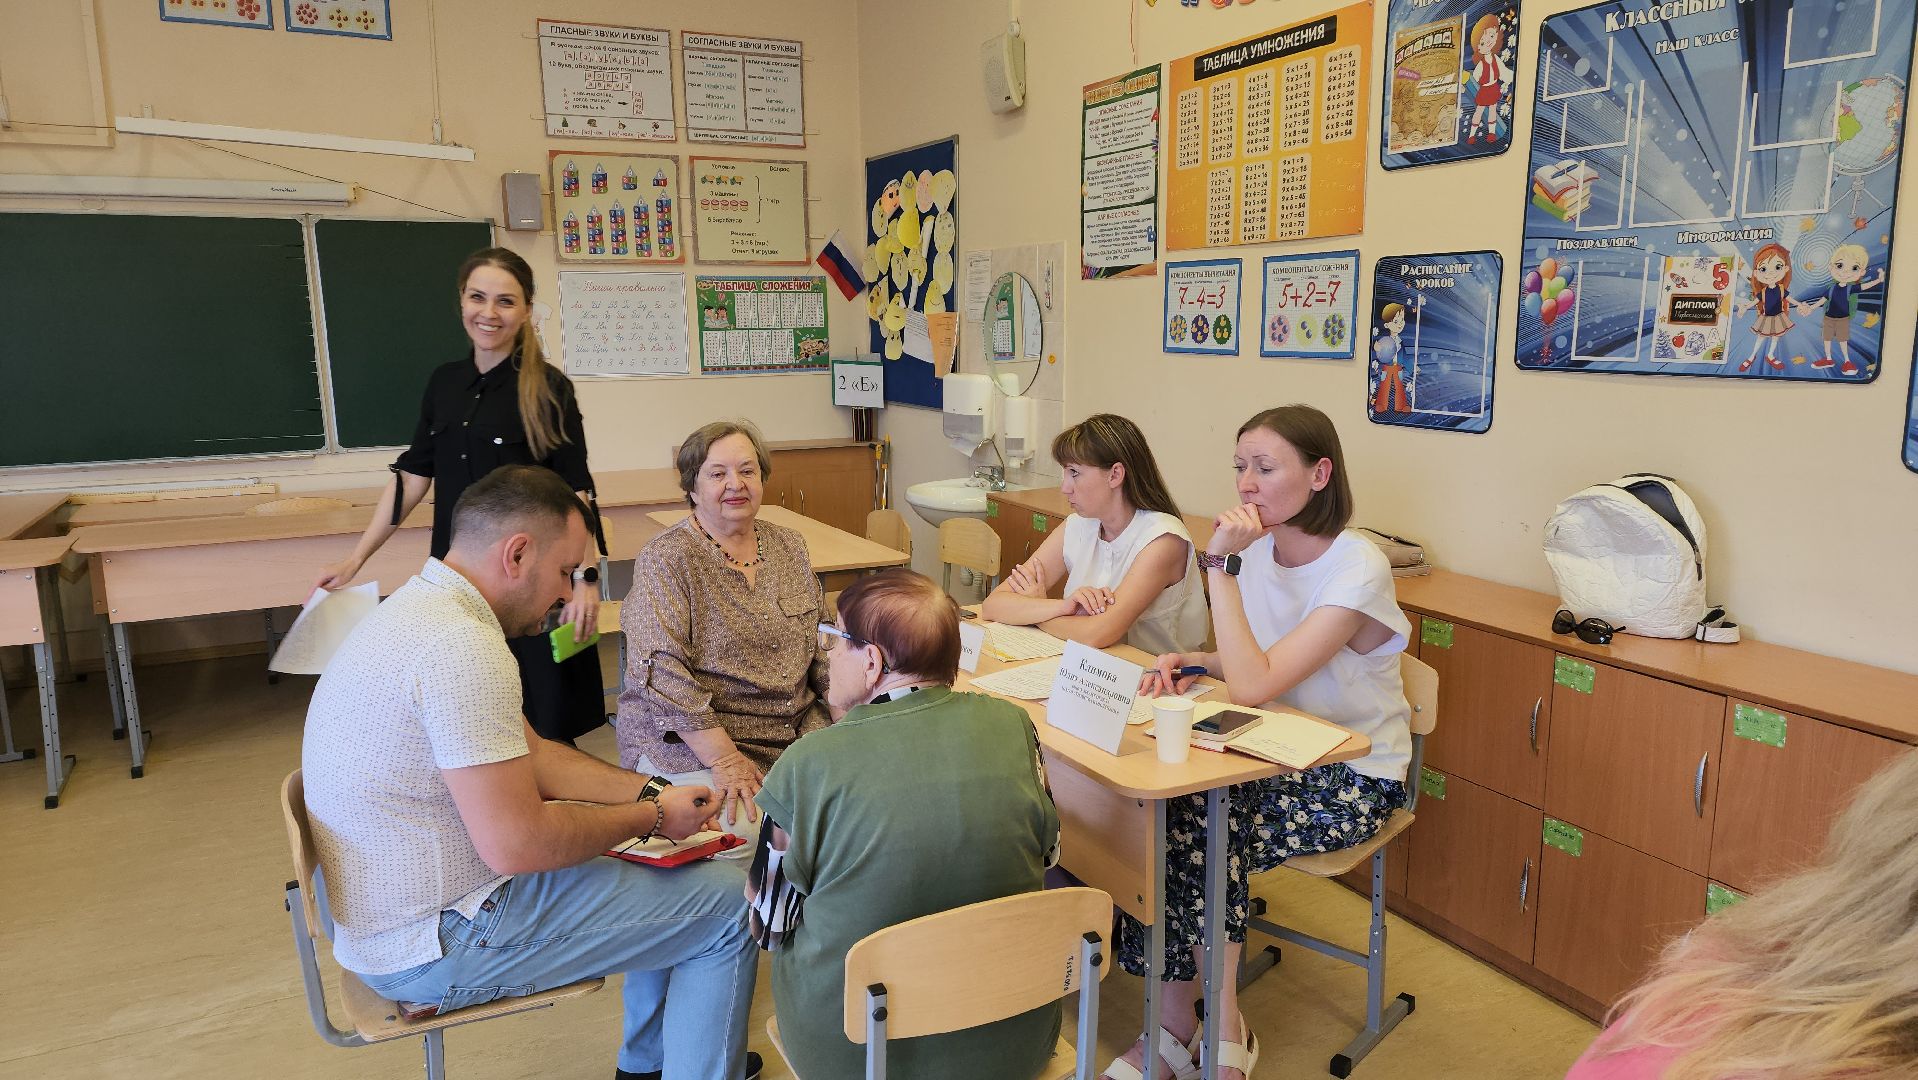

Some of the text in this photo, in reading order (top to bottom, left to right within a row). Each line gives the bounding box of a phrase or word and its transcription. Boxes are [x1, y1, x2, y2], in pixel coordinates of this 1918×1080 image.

[550, 26, 659, 42] ГЛАСНЫЕ ЗВУКИ И БУКВЫ
[688, 37, 736, 47] СОГЛАСНЫЕ
[739, 42, 762, 50] ЗВУКИ
[771, 45, 797, 53] БУКВЫ
[1202, 23, 1325, 72] ТАБЛИЦА УМНОЖЕНИЯ
[1712, 263, 1730, 290] 5
[713, 281, 812, 291] ТАБЛИЦА СЛОЖЕНИЯ
[1675, 301, 1715, 309] ДИПЛОМ
[839, 376, 878, 392] 2 «Е»
